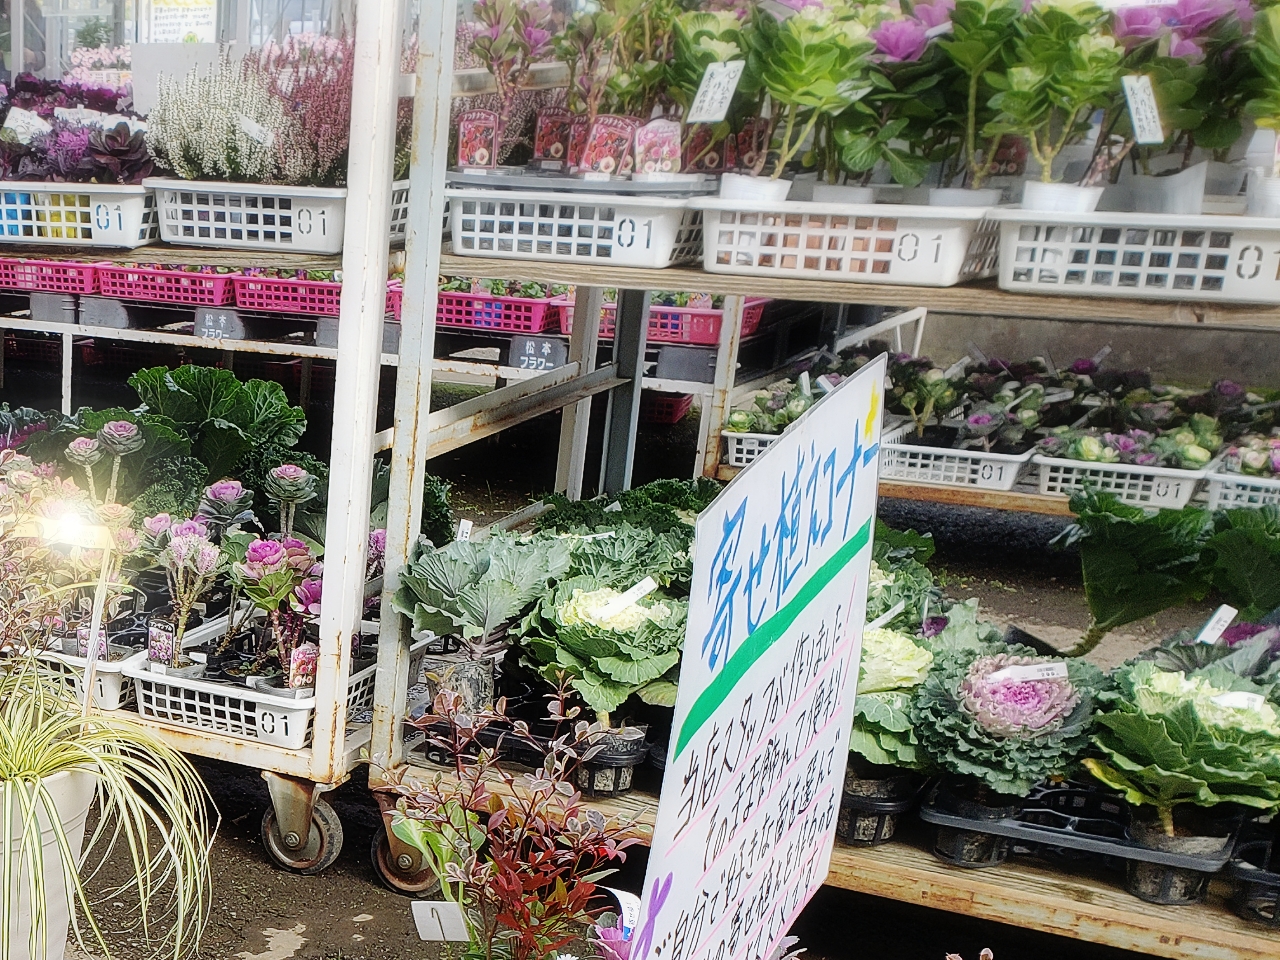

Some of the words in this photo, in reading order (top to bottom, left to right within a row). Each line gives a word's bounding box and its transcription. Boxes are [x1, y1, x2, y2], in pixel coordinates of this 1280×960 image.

[95, 203, 123, 231] 01
[297, 208, 326, 236] 01
[617, 217, 653, 249] 01
[897, 232, 943, 264] 01
[205, 313, 227, 328] 松本
[201, 327, 229, 339] フラワー
[525, 340, 552, 356] 松本
[520, 356, 554, 369] フラワー
[981, 464, 1004, 482] 01
[1155, 481, 1181, 499] 01
[261, 711, 289, 737] 01
